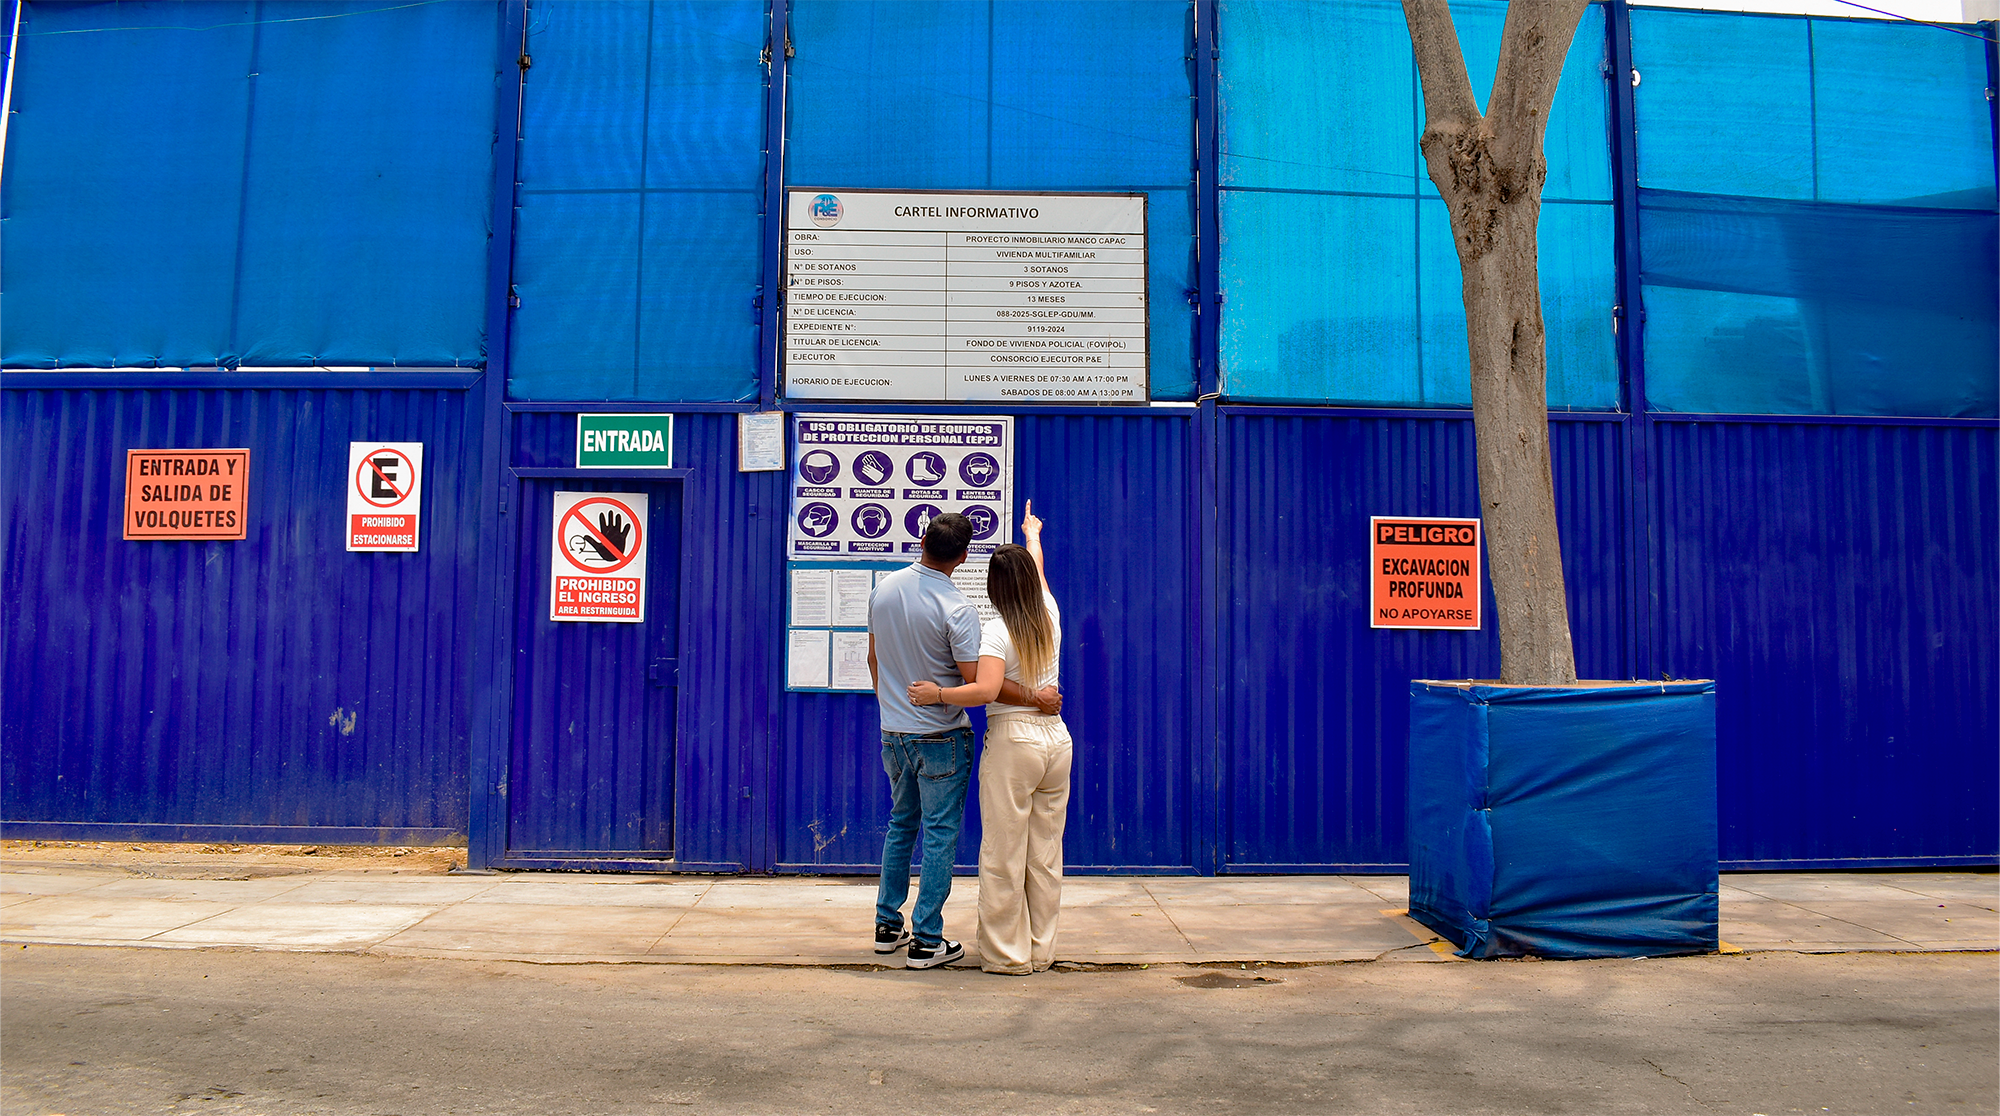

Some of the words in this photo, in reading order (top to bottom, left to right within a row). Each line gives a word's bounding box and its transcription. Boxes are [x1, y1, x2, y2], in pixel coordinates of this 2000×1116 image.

[895, 206, 941, 217] CARTEL
[946, 207, 1039, 218] INFORMATIVO
[1087, 341, 1126, 349] (FOVIPOL)
[810, 423, 834, 431] USO
[838, 423, 919, 433] OBLIGATORIO
[922, 424, 936, 433] DE
[939, 424, 992, 434] EQUIPOS
[584, 430, 664, 452] ENTRADA
[803, 433, 818, 441] DE
[821, 433, 899, 442] PROTECCION
[902, 435, 963, 444] PERSONAL
[966, 436, 998, 444] (EPP)
[140, 459, 219, 475] ENTRADA
[226, 459, 237, 475] Y
[142, 485, 202, 502] SALIDA
[210, 485, 231, 501] DE
[135, 511, 236, 529] VOLQUETES
[362, 517, 405, 527] PROHIBIDO
[354, 535, 412, 544] ESTACIONARSE
[1380, 526, 1473, 543] PELIGRO
[1383, 559, 1469, 576] EXCAVACION
[560, 579, 636, 591] PROHIBIDO
[1390, 581, 1463, 598] PROFUNDA
[559, 592, 574, 602] EL
[579, 593, 636, 604] INGRESO
[581, 607, 636, 616] RESTRINGUIDA
[1380, 608, 1398, 618] NO
[1402, 609, 1472, 620] APOYARSE
